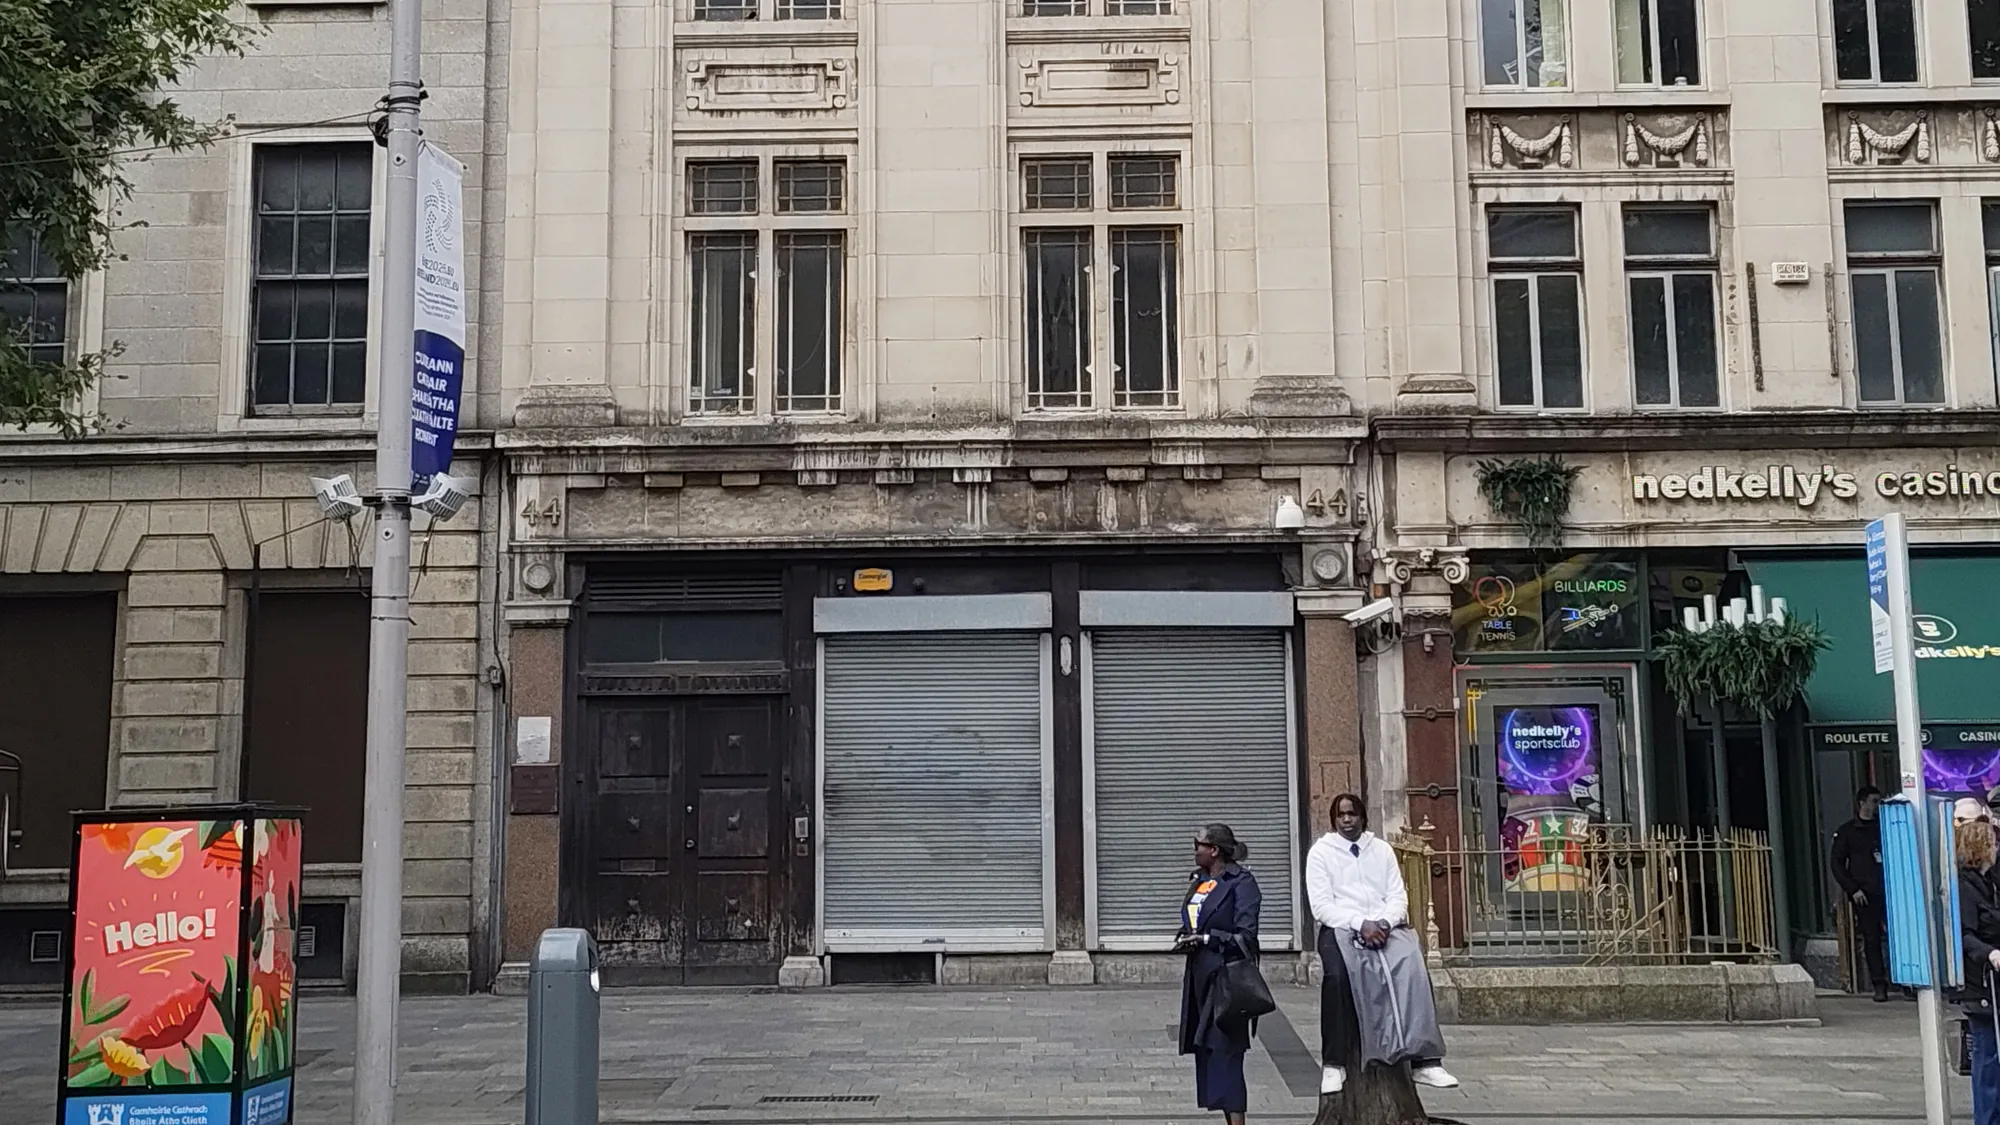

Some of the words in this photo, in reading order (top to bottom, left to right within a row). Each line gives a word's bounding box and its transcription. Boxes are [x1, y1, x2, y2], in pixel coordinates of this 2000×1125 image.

[1633, 464, 1858, 506] nedkelly's
[1306, 488, 1348, 517] 44
[520, 498, 561, 527] 44
[1554, 580, 1628, 593] BILLIARDS
[1481, 620, 1513, 630] TABLE
[1481, 631, 1516, 641] TENNIS
[1512, 724, 1582, 739] nedkelly's
[1825, 732, 1890, 743] ROULETTE
[1959, 731, 2000, 742] CASIN
[1514, 737, 1581, 754] sportsclub
[103, 908, 217, 955] Hello!
